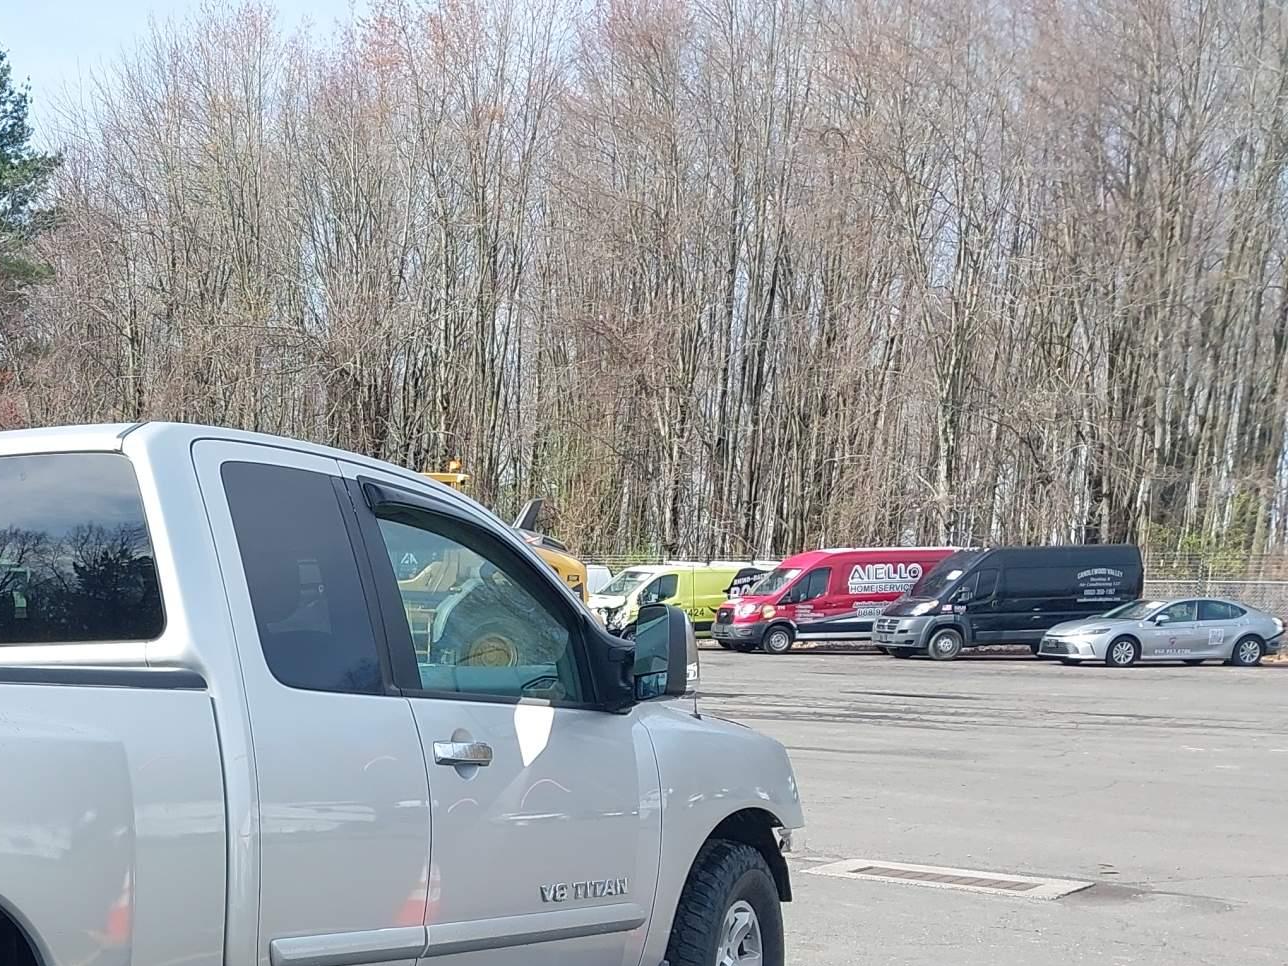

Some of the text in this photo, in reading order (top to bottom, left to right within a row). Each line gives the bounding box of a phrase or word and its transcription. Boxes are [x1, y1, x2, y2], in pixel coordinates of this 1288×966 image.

[849, 563, 923, 581] AIELLO
[540, 877, 629, 902] V8 TITAN
